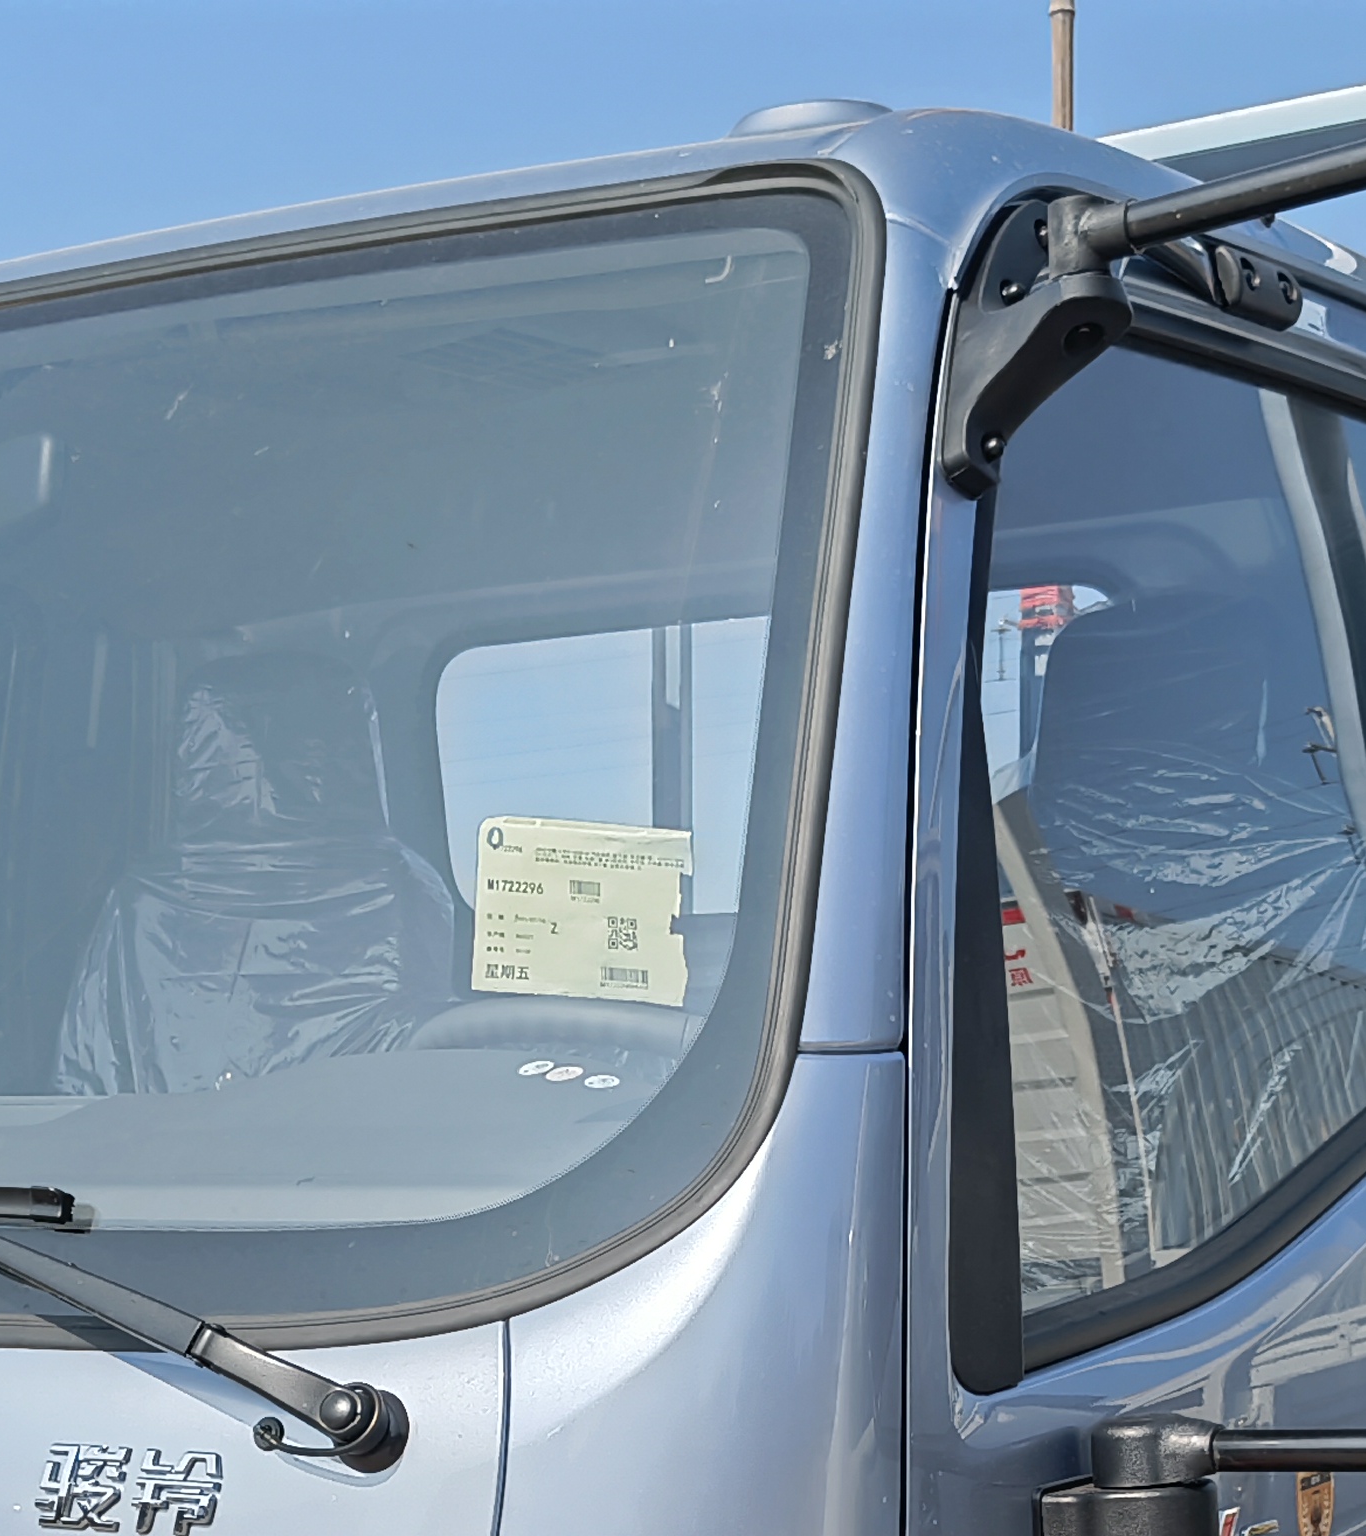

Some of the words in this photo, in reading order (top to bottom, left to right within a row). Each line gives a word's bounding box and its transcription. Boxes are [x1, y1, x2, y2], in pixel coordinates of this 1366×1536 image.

[487, 879, 544, 894] M1722296
[485, 963, 530, 981] 星期五
